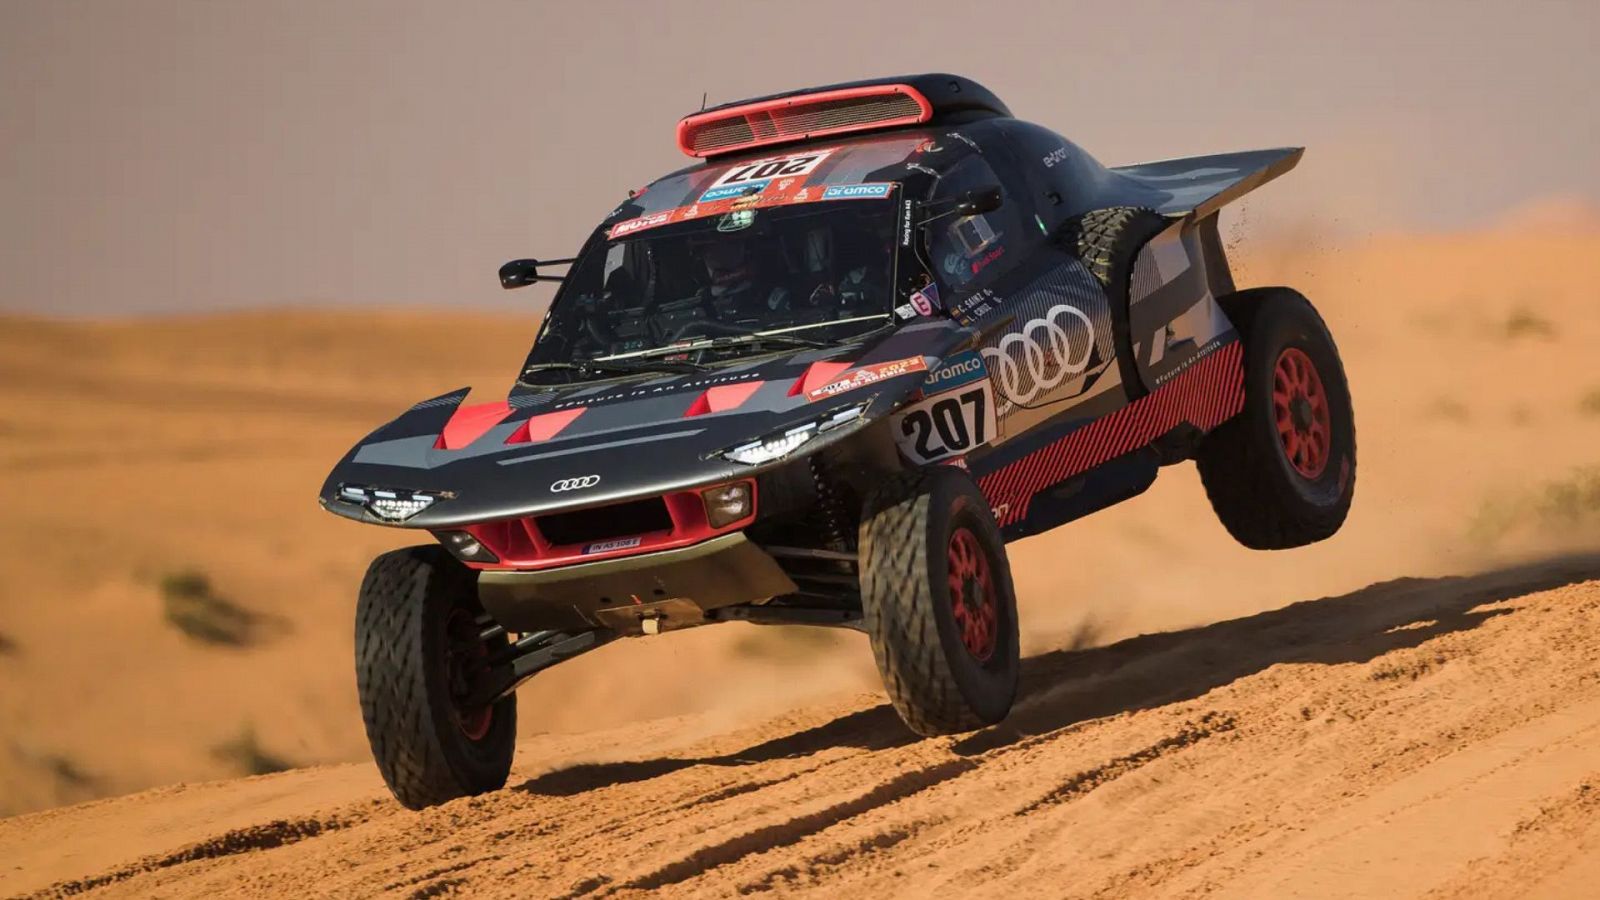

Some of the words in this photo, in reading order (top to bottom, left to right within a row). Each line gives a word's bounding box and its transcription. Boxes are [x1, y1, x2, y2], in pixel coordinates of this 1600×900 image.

[722, 155, 819, 184] 207
[827, 185, 884, 196] aramco
[924, 358, 981, 384] aramco
[902, 388, 985, 459] 207
